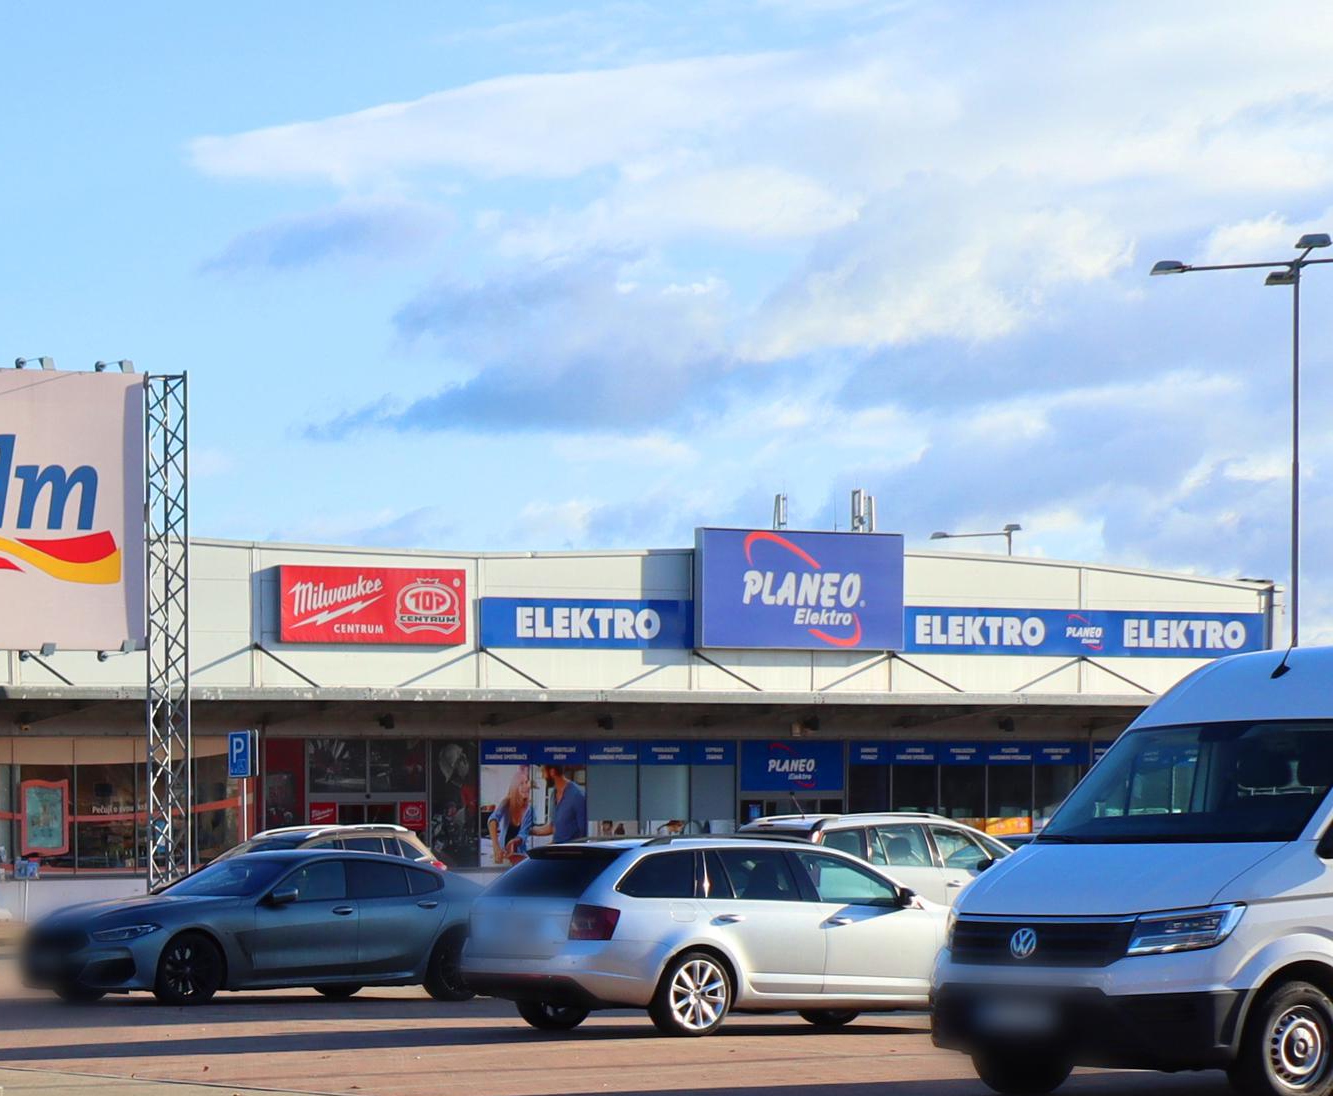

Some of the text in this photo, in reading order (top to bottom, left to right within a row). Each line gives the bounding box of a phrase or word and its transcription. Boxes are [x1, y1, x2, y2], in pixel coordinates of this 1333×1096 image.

[287, 575, 383, 617] Milwaukee
[742, 570, 862, 608] PLANEO
[409, 591, 446, 611] TOP
[399, 615, 456, 623] CENTRUM
[516, 606, 661, 640] ELEKTRO
[793, 608, 853, 626] Elektro
[333, 624, 384, 634] CENTRUM
[915, 614, 1046, 647] ELEKTRO
[1065, 626, 1103, 638] PLANEO
[1123, 618, 1247, 650] ELEKTRO
[233, 737, 245, 763] P
[768, 758, 815, 772] PLANEO
